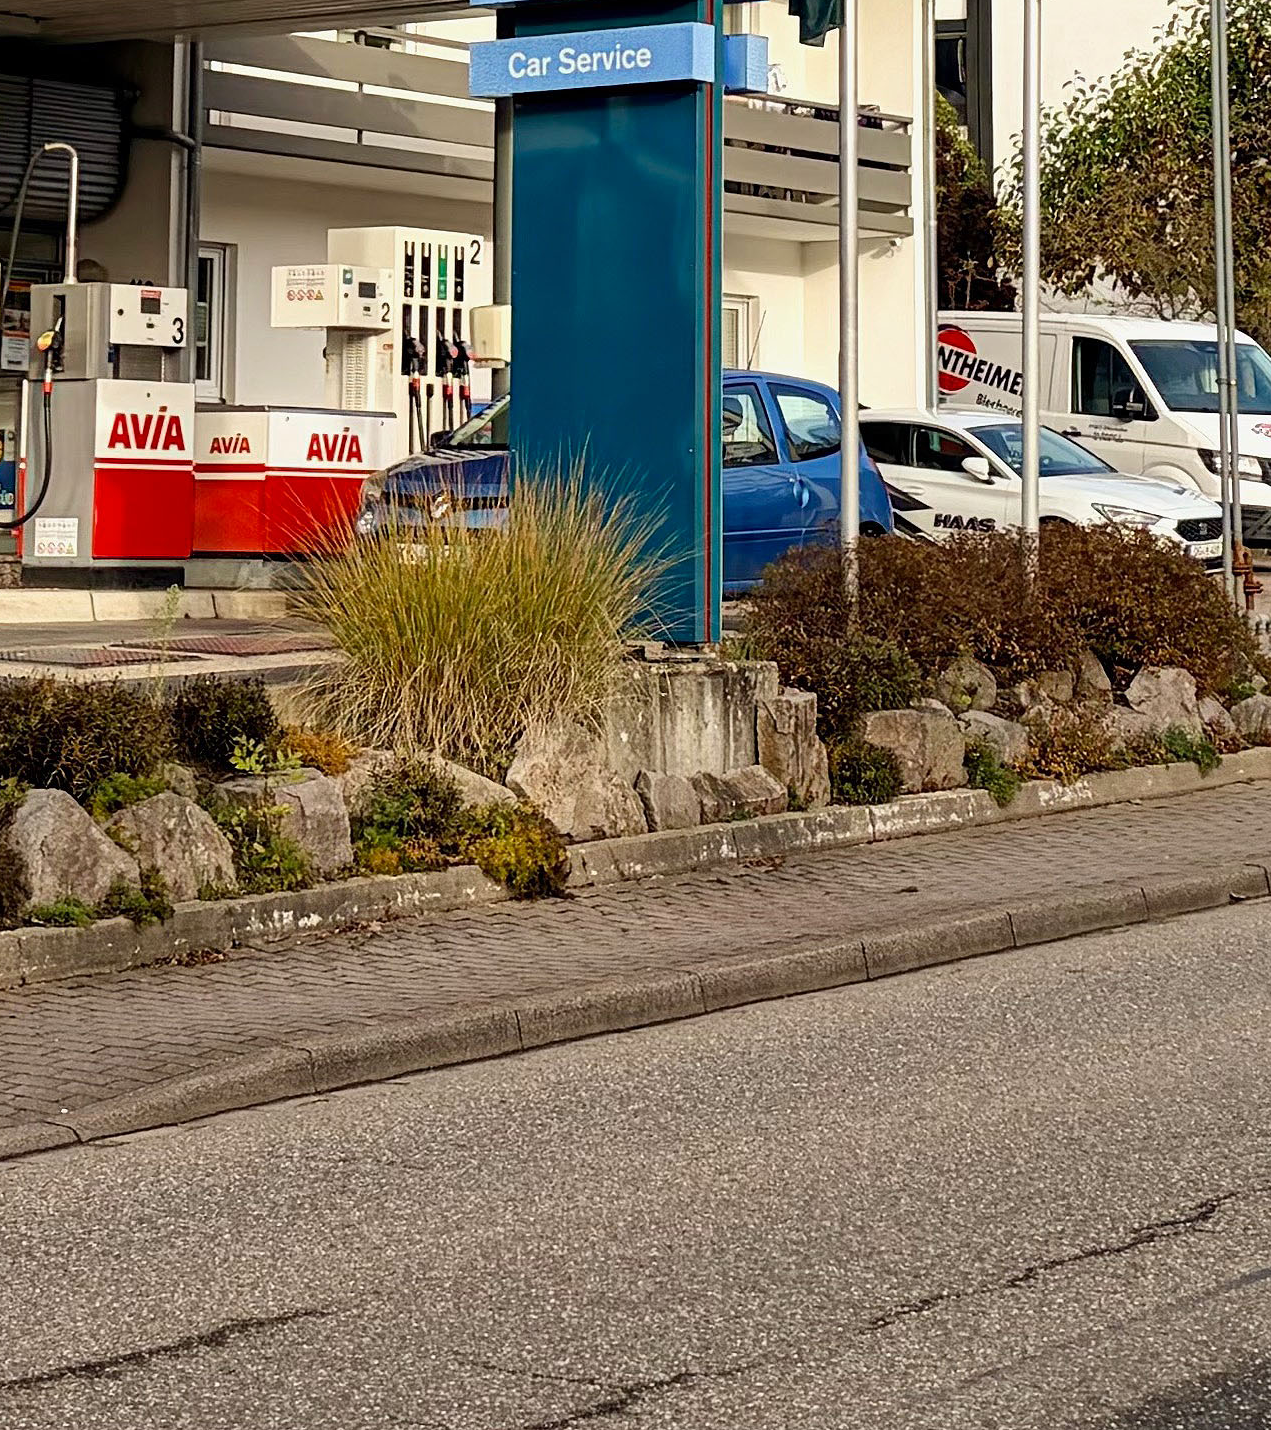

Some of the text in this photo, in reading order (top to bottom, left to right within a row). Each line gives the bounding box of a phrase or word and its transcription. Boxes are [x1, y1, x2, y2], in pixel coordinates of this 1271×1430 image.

[508, 42, 653, 79] Car Service
[469, 240, 481, 265] 2
[381, 302, 391, 323] 2
[171, 317, 184, 344] 3
[107, 405, 186, 451] AVIA
[209, 432, 251, 454] AVIA
[306, 426, 363, 463] AVIA
[932, 513, 997, 532] HAAS
